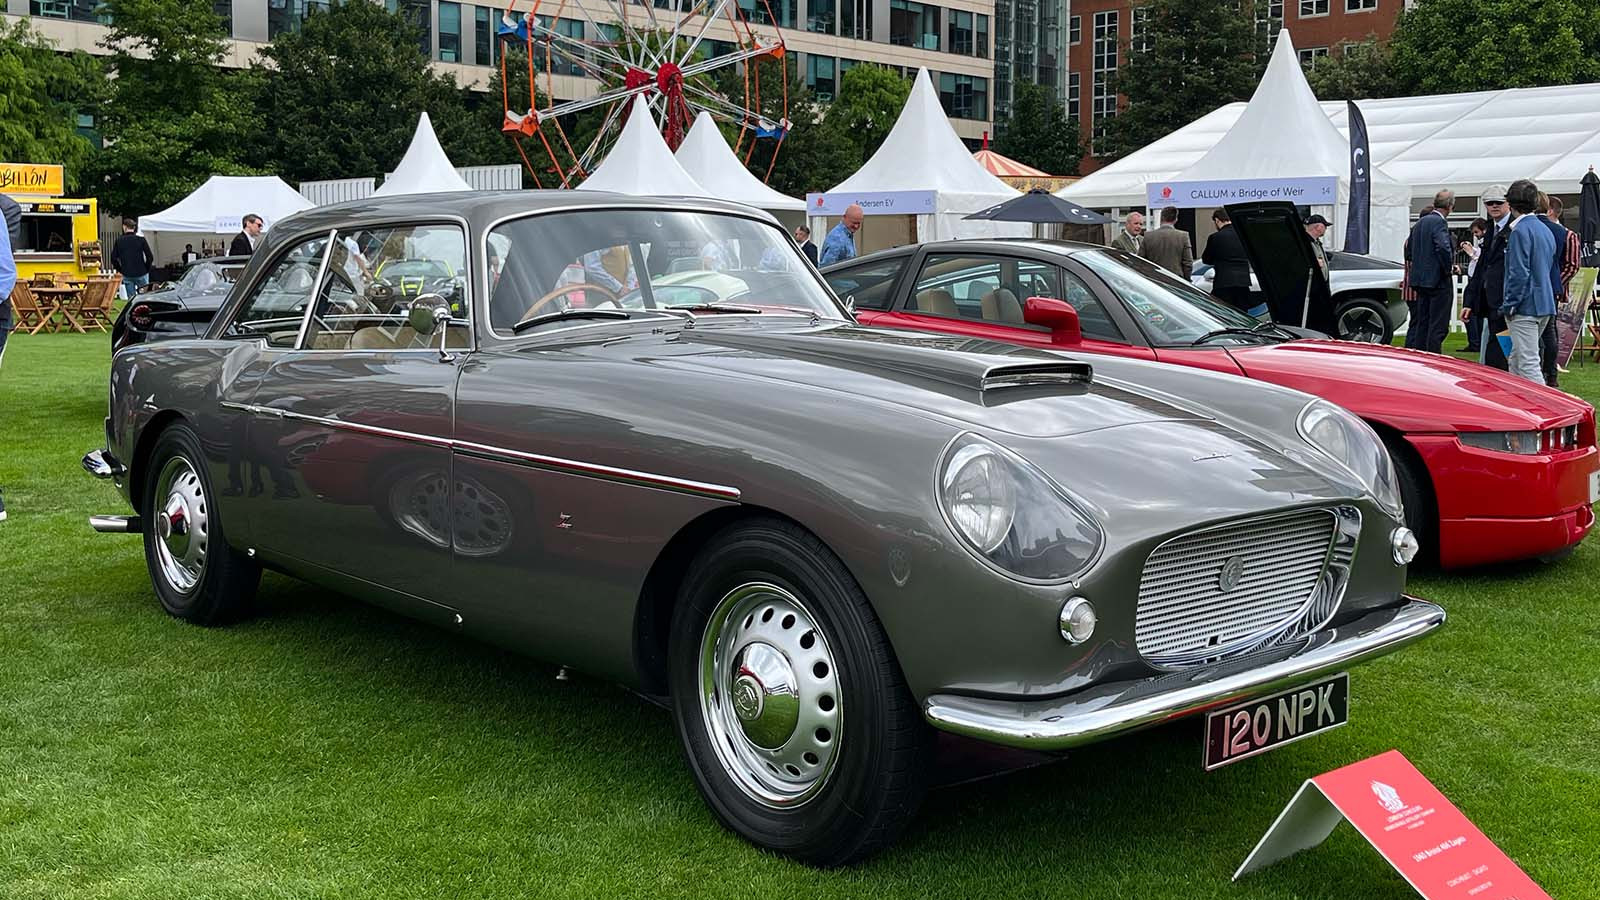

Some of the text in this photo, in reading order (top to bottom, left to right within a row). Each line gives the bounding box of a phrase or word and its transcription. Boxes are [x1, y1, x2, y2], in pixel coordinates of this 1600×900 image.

[1190, 189, 1229, 199] CALLUM
[1238, 188, 1268, 199] Bridge
[1270, 187, 1281, 197] of
[1283, 186, 1304, 196] Weir
[1322, 187, 1331, 195] 14
[885, 199, 895, 207] EV
[1223, 683, 1335, 758] 120 NPK
